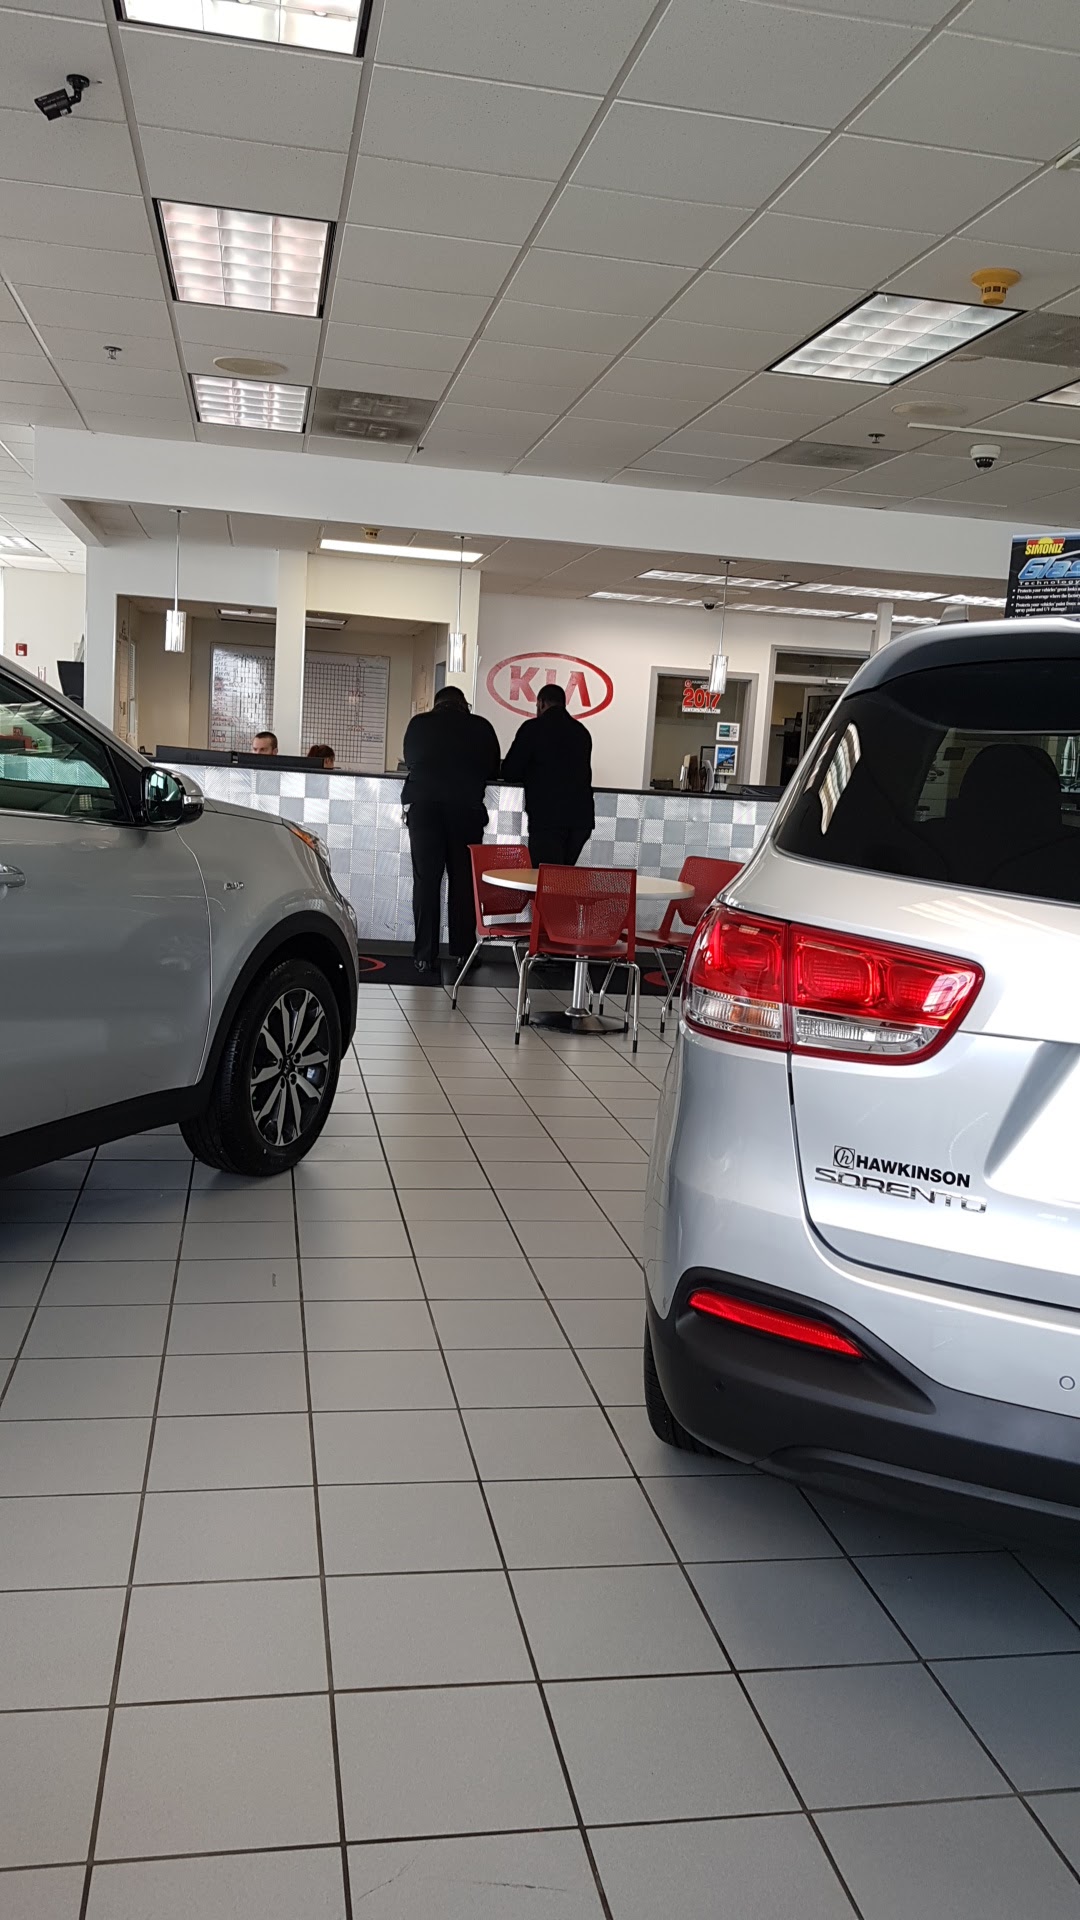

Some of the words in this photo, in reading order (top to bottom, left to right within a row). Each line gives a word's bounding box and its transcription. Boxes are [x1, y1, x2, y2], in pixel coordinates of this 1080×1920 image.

[1025, 543, 1063, 555] SIMONIZ
[682, 687, 722, 709] 2017
[856, 1154, 971, 1188] HAWKINSON
[814, 1167, 988, 1214] SORENTO
